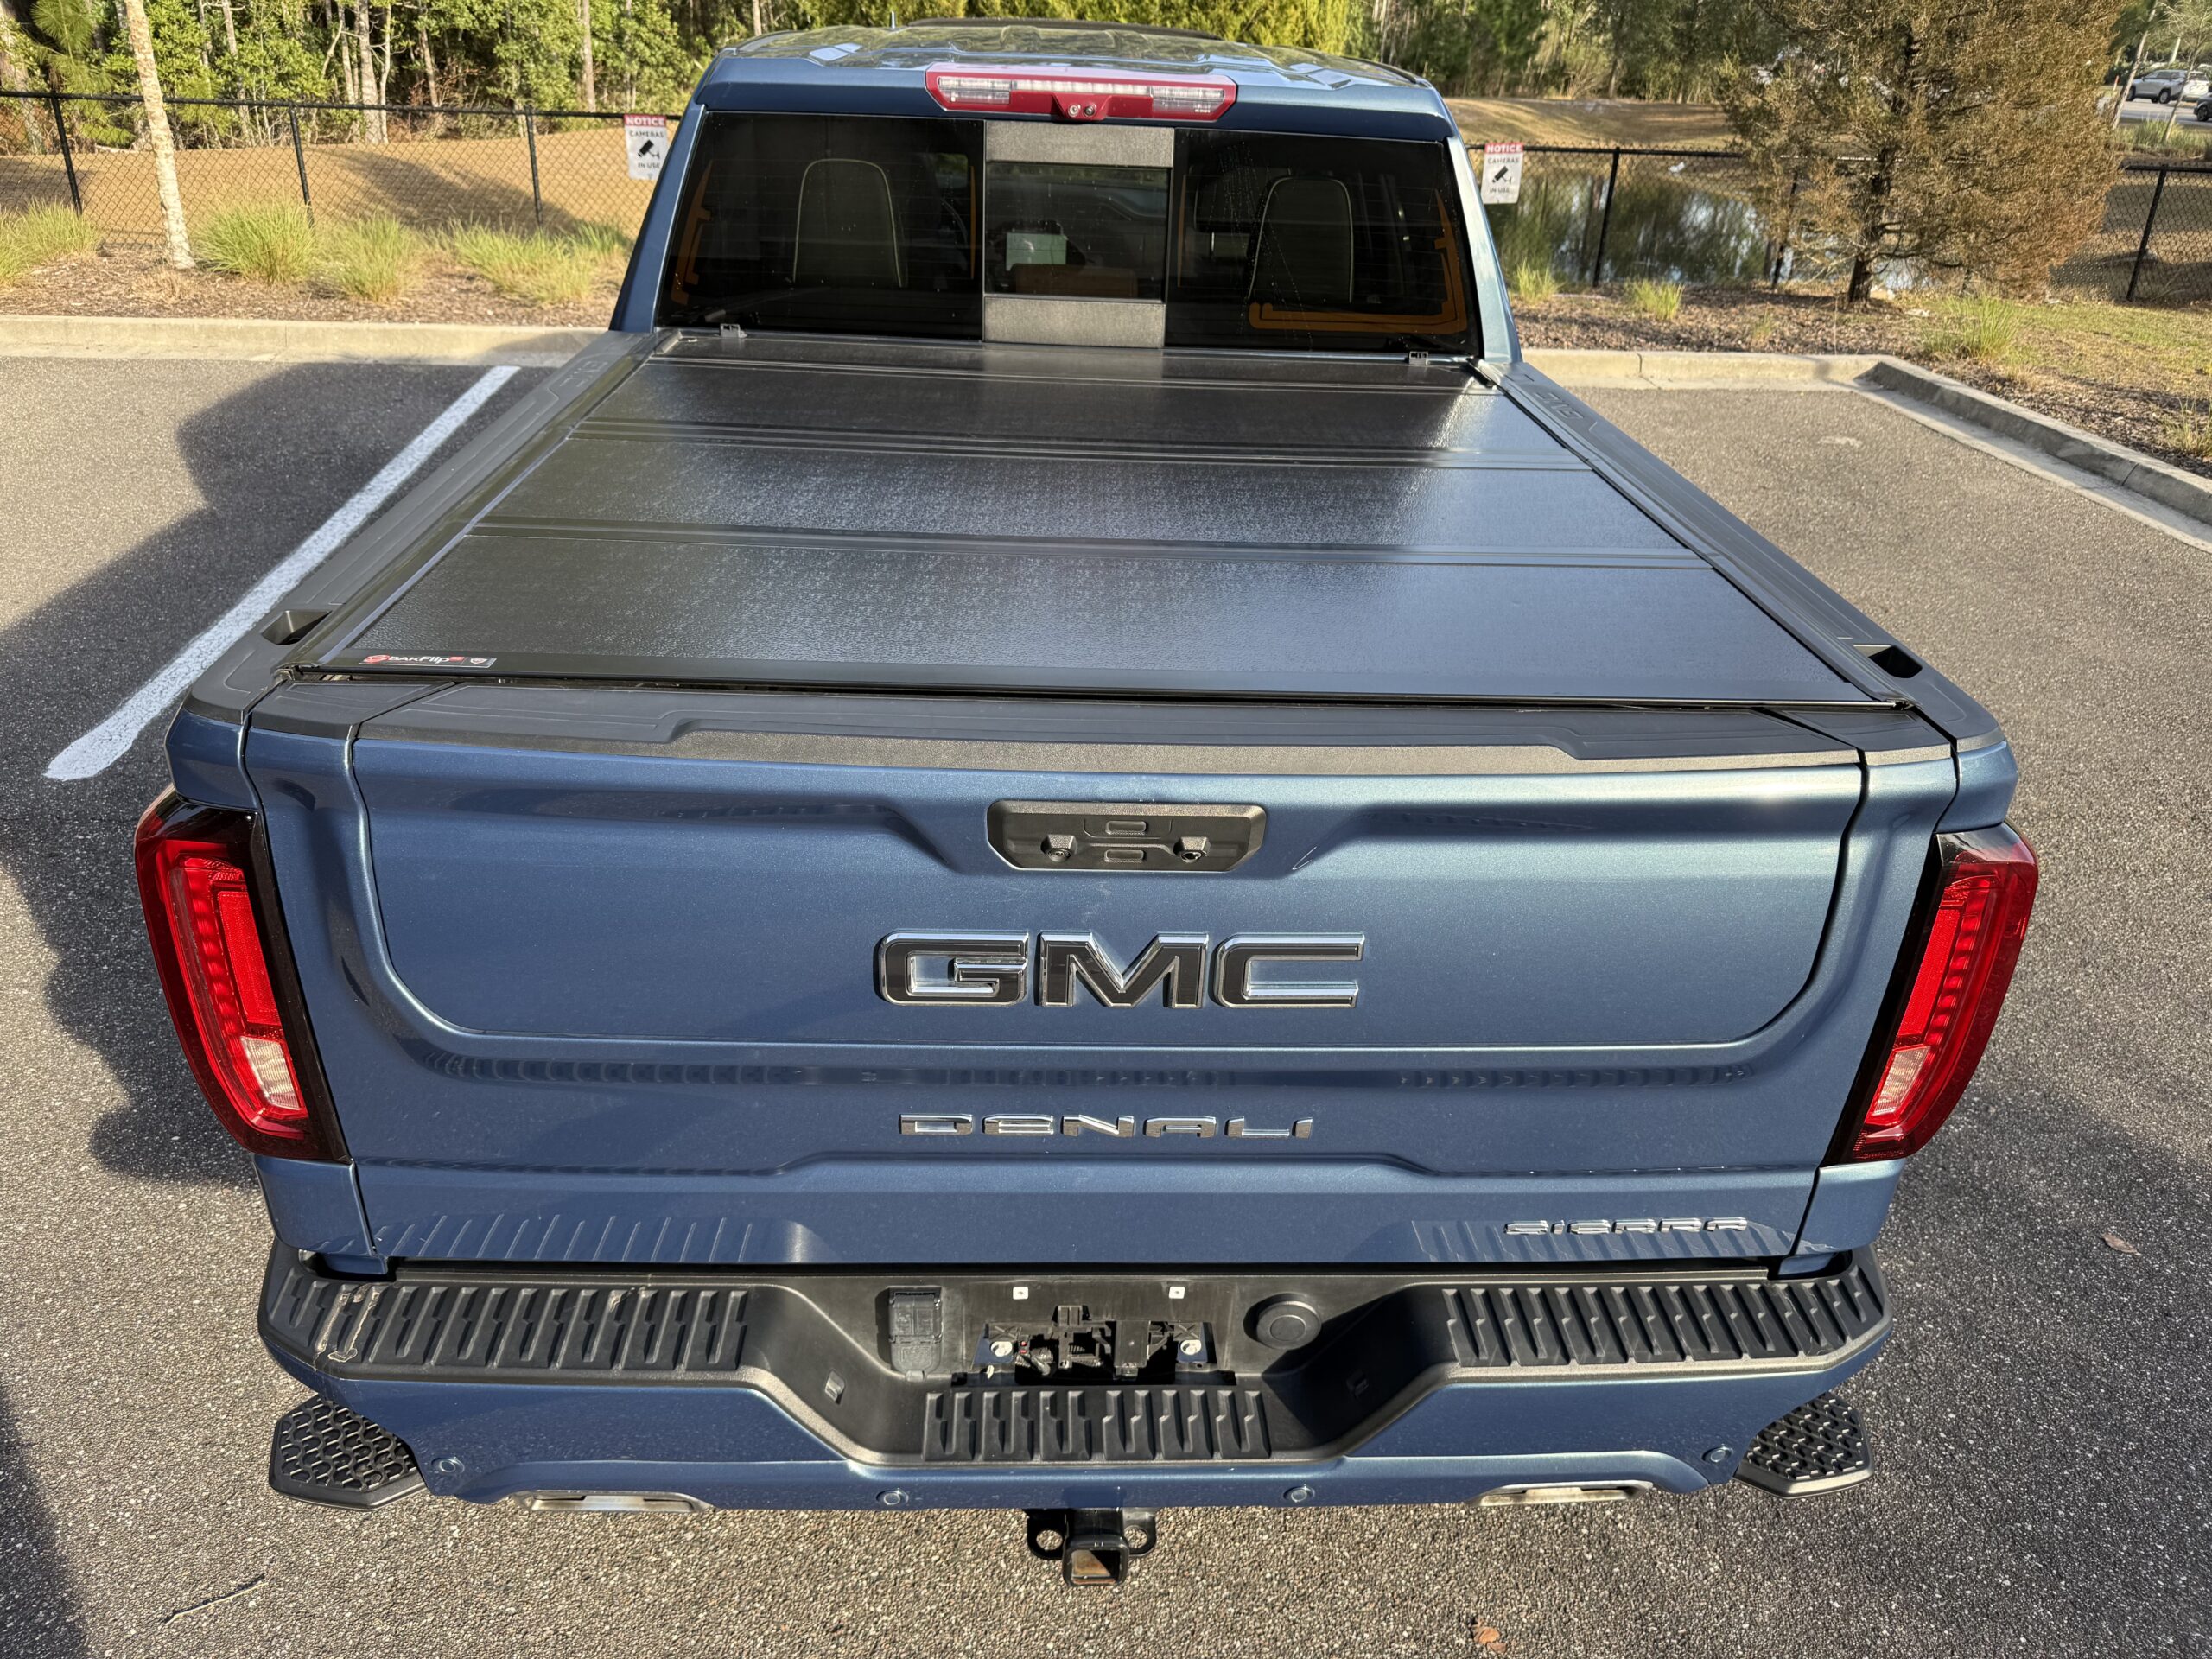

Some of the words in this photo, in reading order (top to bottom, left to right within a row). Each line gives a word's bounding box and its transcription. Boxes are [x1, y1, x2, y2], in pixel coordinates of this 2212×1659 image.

[626, 116, 665, 126] NOTICE
[1487, 144, 1522, 153] NOTICE
[874, 930, 1365, 1009] GMC
[898, 1114, 1313, 1138] DENALI
[1503, 1217, 1748, 1236] SIERRA
